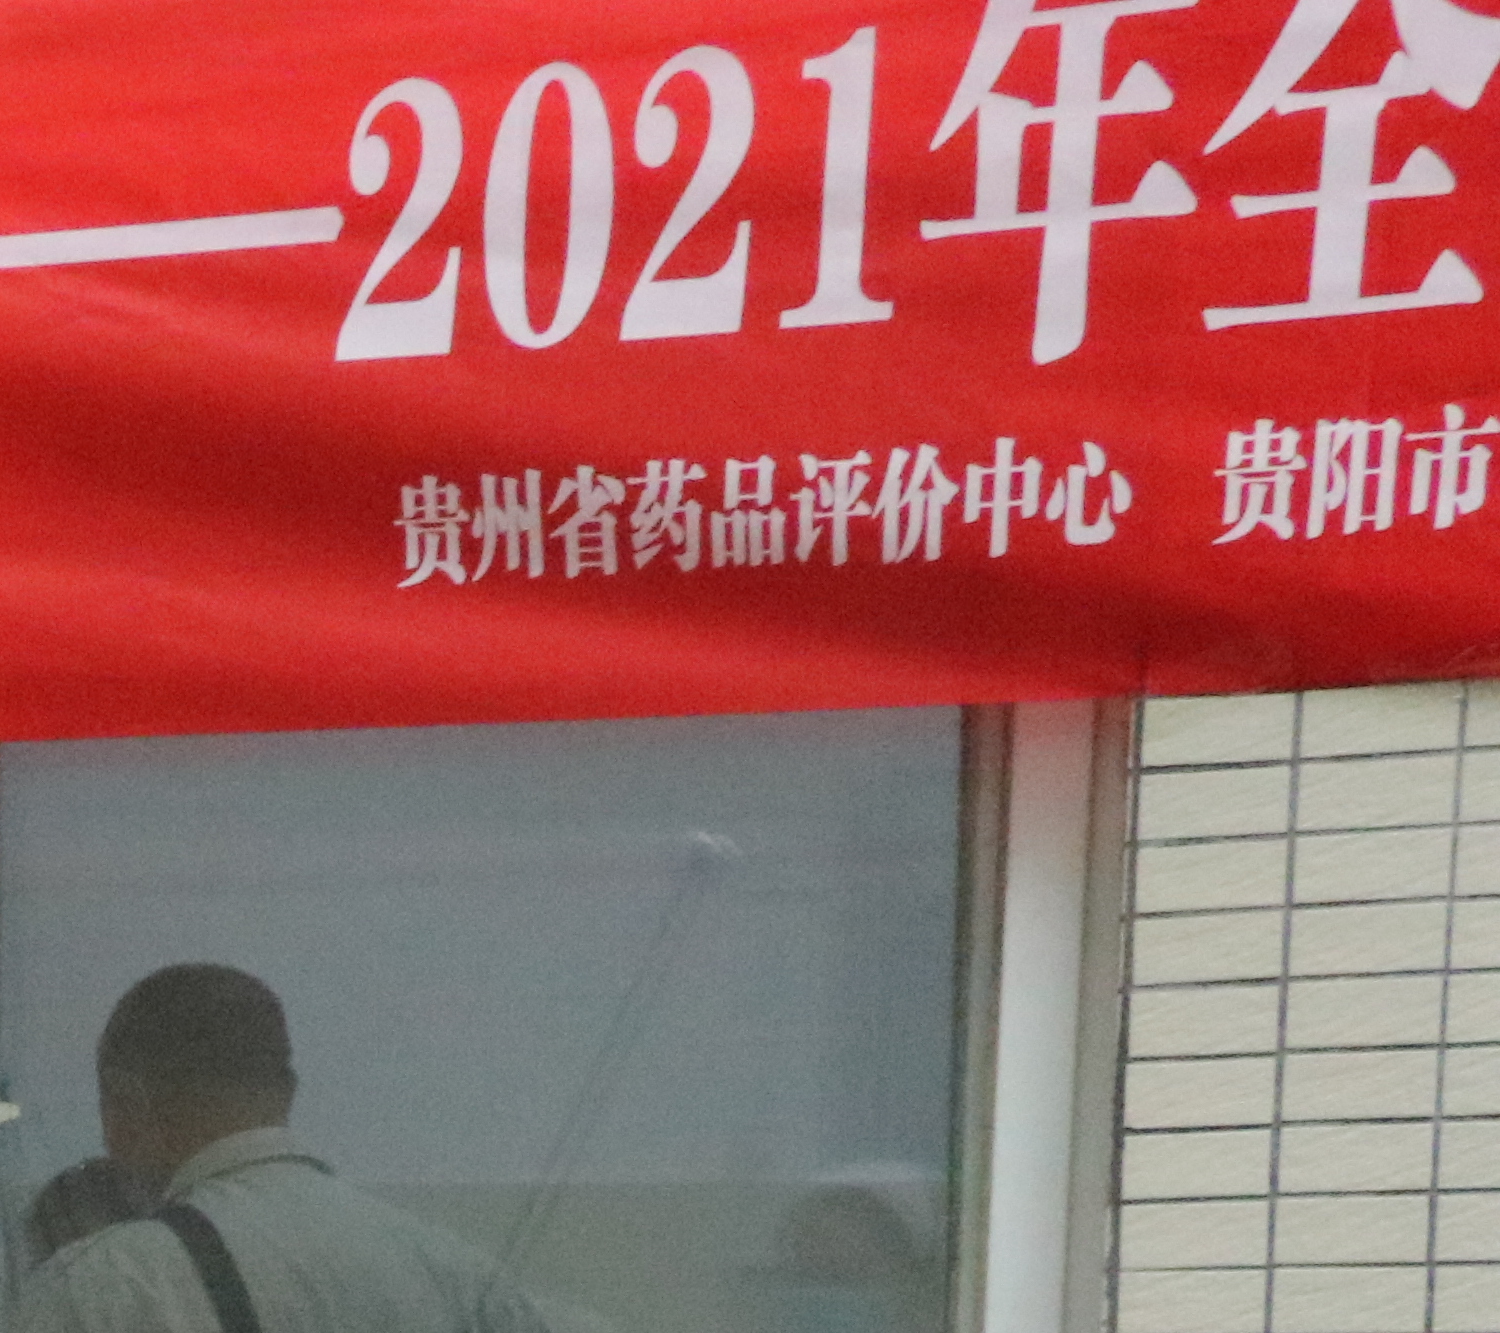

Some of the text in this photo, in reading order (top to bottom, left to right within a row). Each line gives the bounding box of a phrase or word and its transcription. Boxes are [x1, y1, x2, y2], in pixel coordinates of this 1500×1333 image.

[392, 402, 1500, 591] 贵州省药品评价中心 贵阳市
